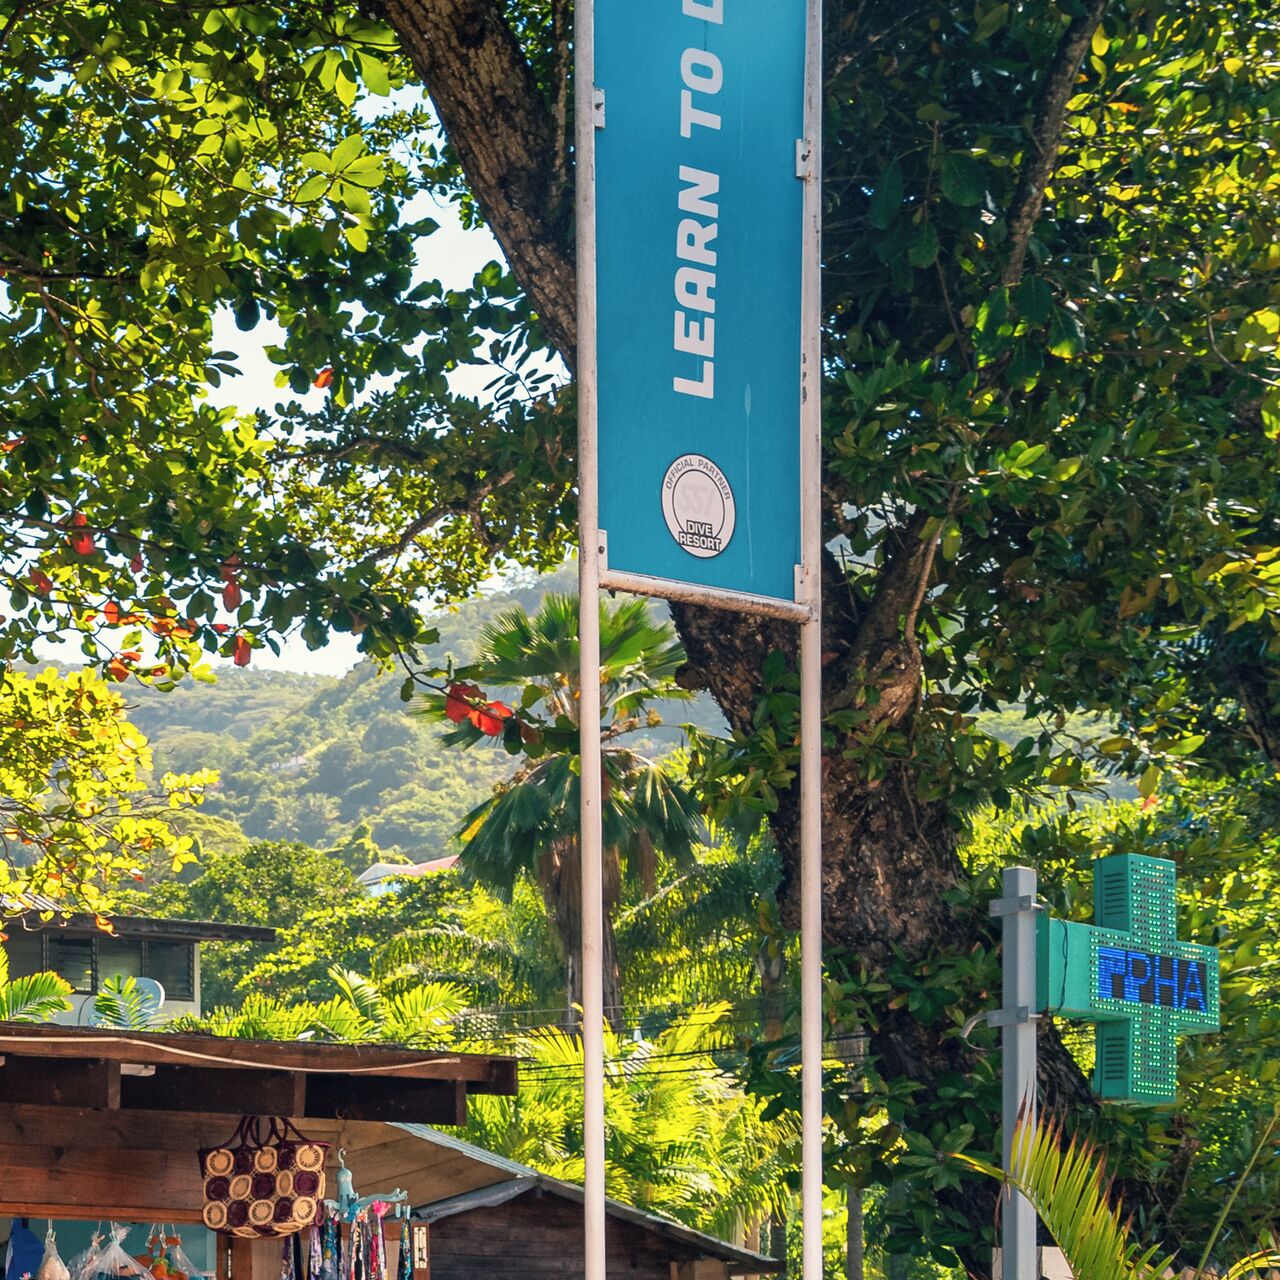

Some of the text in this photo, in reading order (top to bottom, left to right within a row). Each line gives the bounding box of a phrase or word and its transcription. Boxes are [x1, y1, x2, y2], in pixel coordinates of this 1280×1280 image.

[680, 47, 723, 138] TO
[673, 165, 720, 400] LEARN
[665, 458, 731, 500] OFFICIAL PARTNER
[679, 532, 721, 550] RESORT
[687, 521, 712, 537] DIVE
